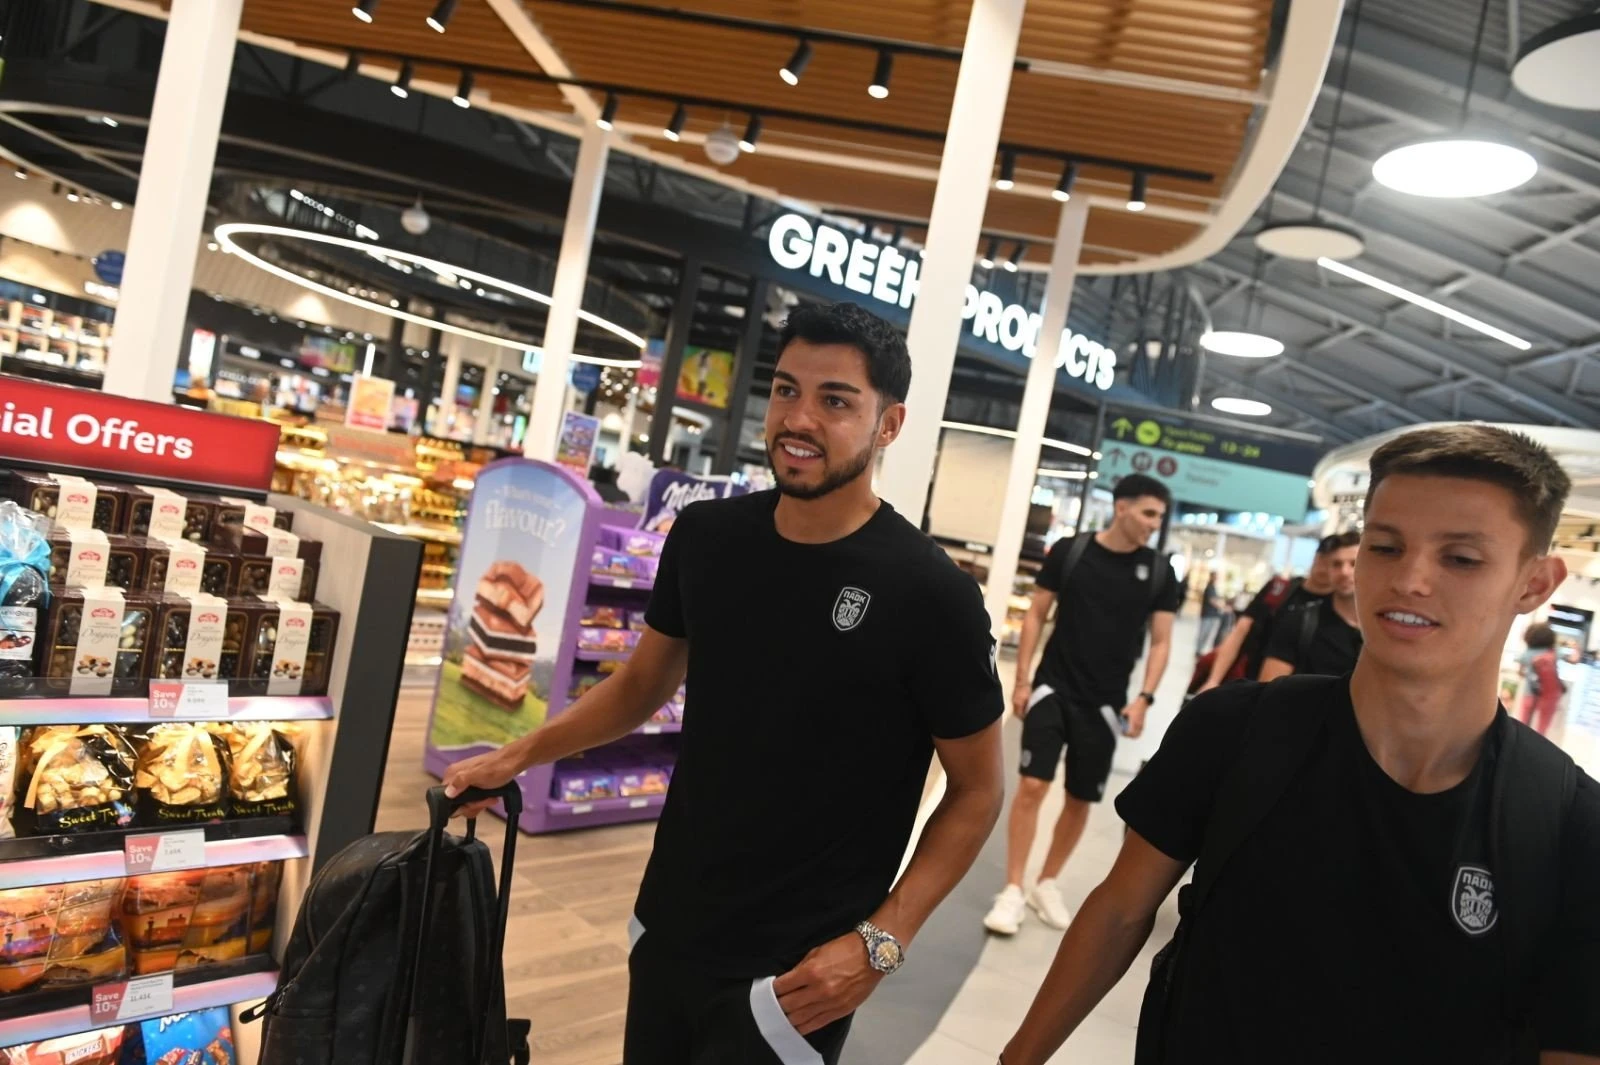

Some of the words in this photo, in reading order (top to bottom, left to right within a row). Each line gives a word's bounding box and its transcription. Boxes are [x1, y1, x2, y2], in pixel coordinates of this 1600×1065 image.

[0, 402, 54, 439] ial
[66, 413, 194, 460] Offers
[485, 499, 567, 547] flavour?
[153, 690, 177, 698] Save
[58, 811, 96, 828] Sweet
[128, 845, 153, 854] Save
[95, 993, 120, 1003] Save
[95, 1002, 118, 1014] 10%
